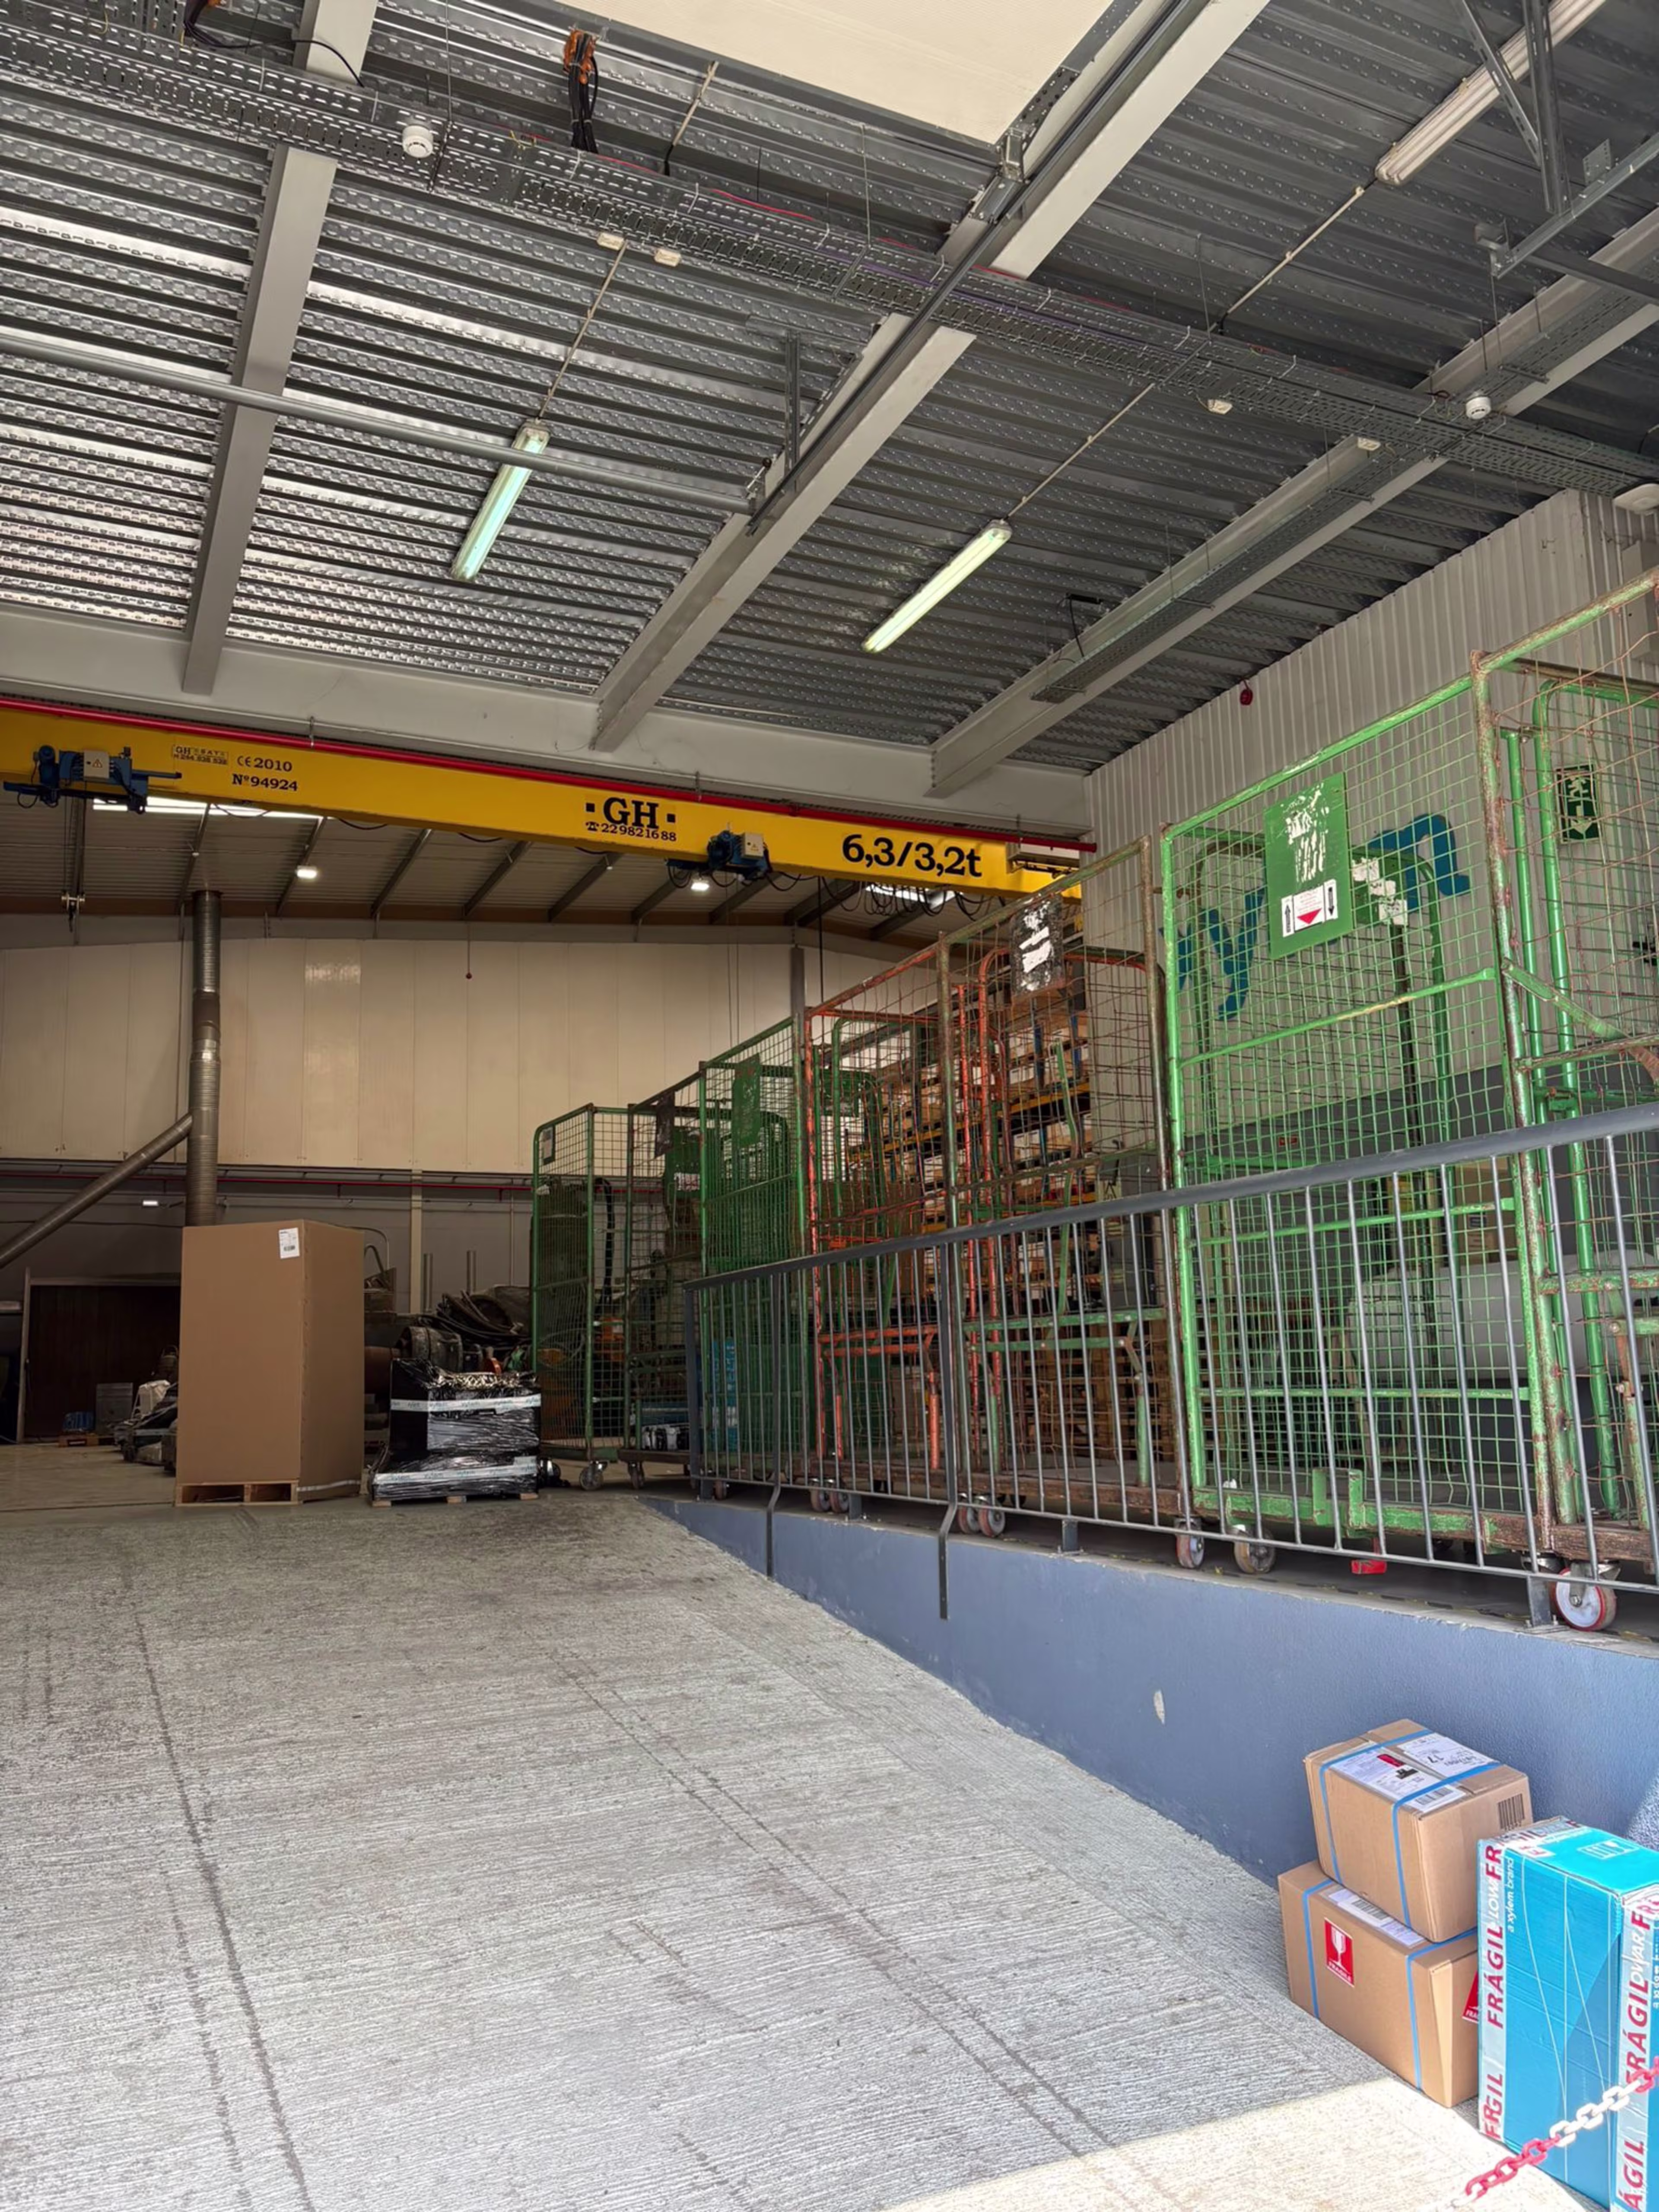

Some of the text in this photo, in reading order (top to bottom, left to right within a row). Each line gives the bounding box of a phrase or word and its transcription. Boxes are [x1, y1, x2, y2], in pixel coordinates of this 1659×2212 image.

[253, 757, 293, 772] 2010
[603, 797, 659, 829] GH
[842, 834, 982, 877] 6,3/3,2t
[1504, 1857, 1514, 1888] brand
[1505, 1891, 1516, 1924] xylem
[1328, 1961, 1352, 1982] FRAGILE
[1484, 1926, 1503, 2029] FRÁGIL
